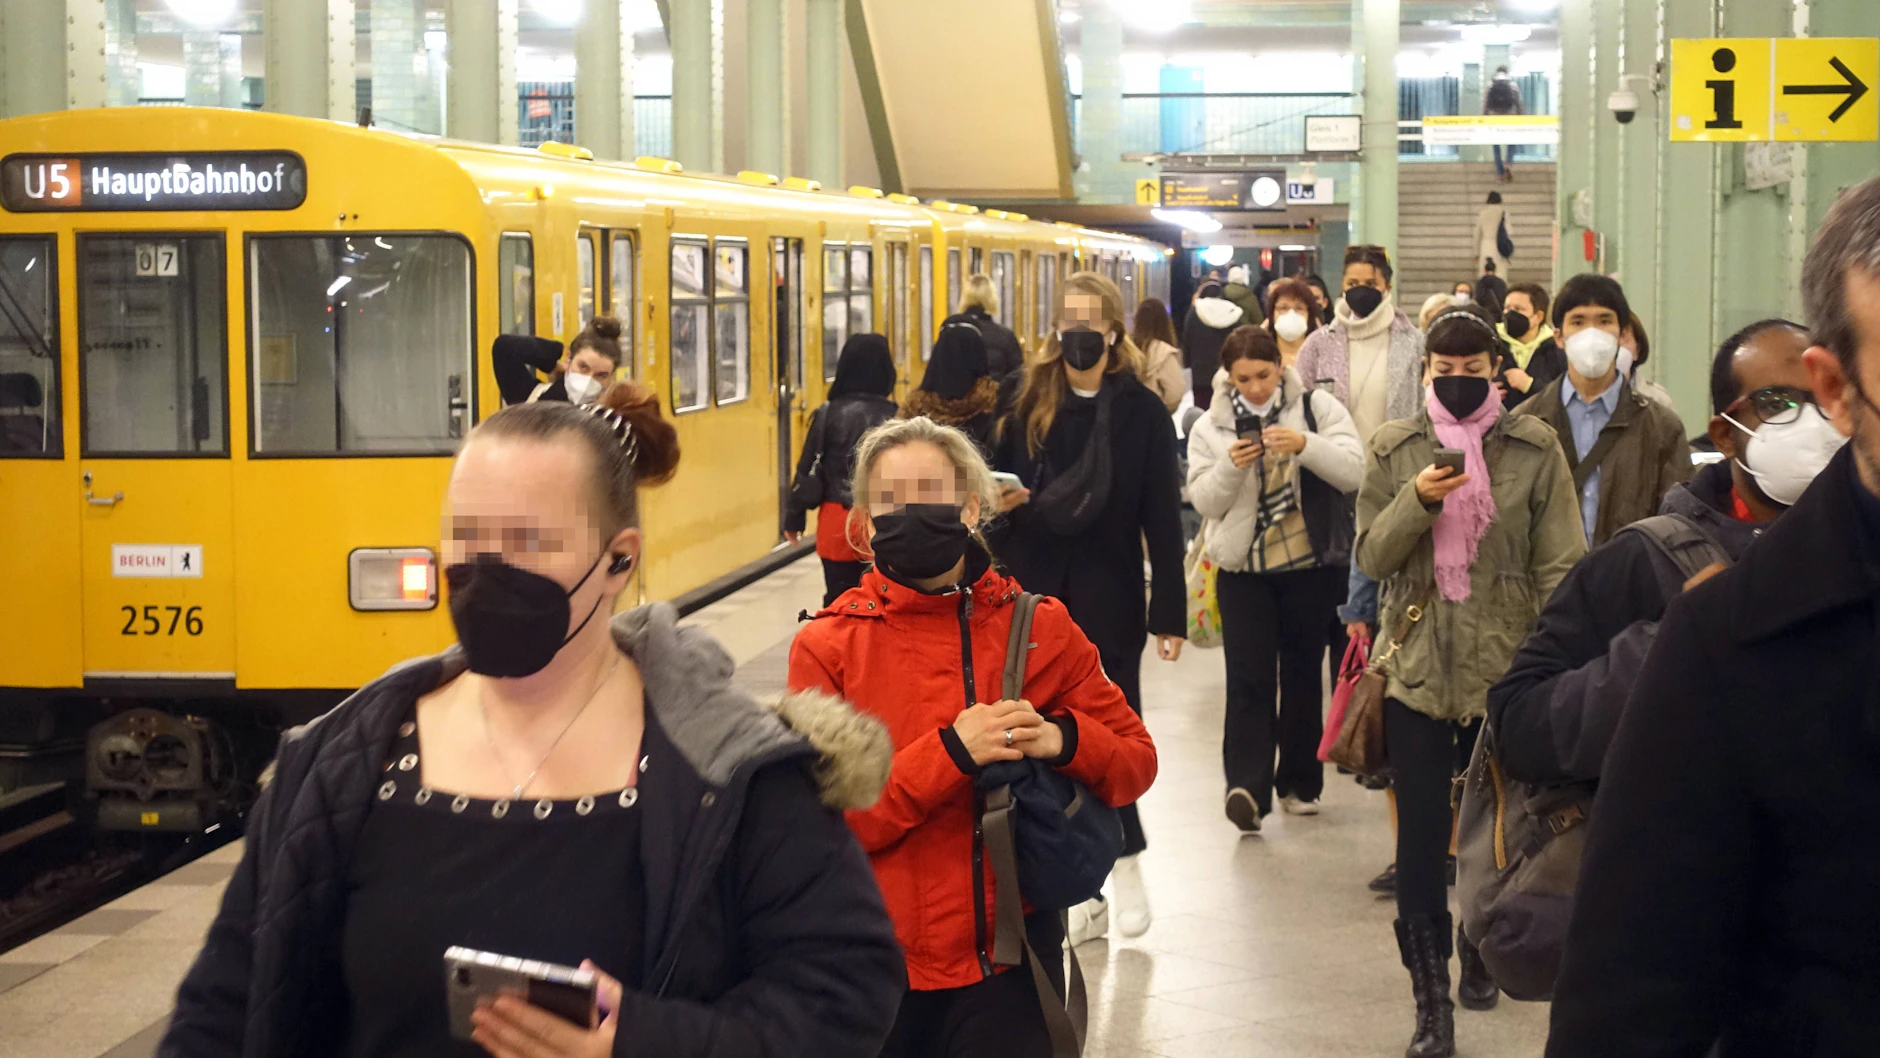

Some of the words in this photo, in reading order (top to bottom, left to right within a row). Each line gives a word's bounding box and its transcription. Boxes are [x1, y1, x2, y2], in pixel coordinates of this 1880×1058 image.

[24, 163, 70, 199] U5
[91, 162, 285, 201] Hauptbahnhof
[139, 252, 174, 271] 07
[119, 554, 166, 567] BERLIN
[121, 605, 204, 636] 2576
